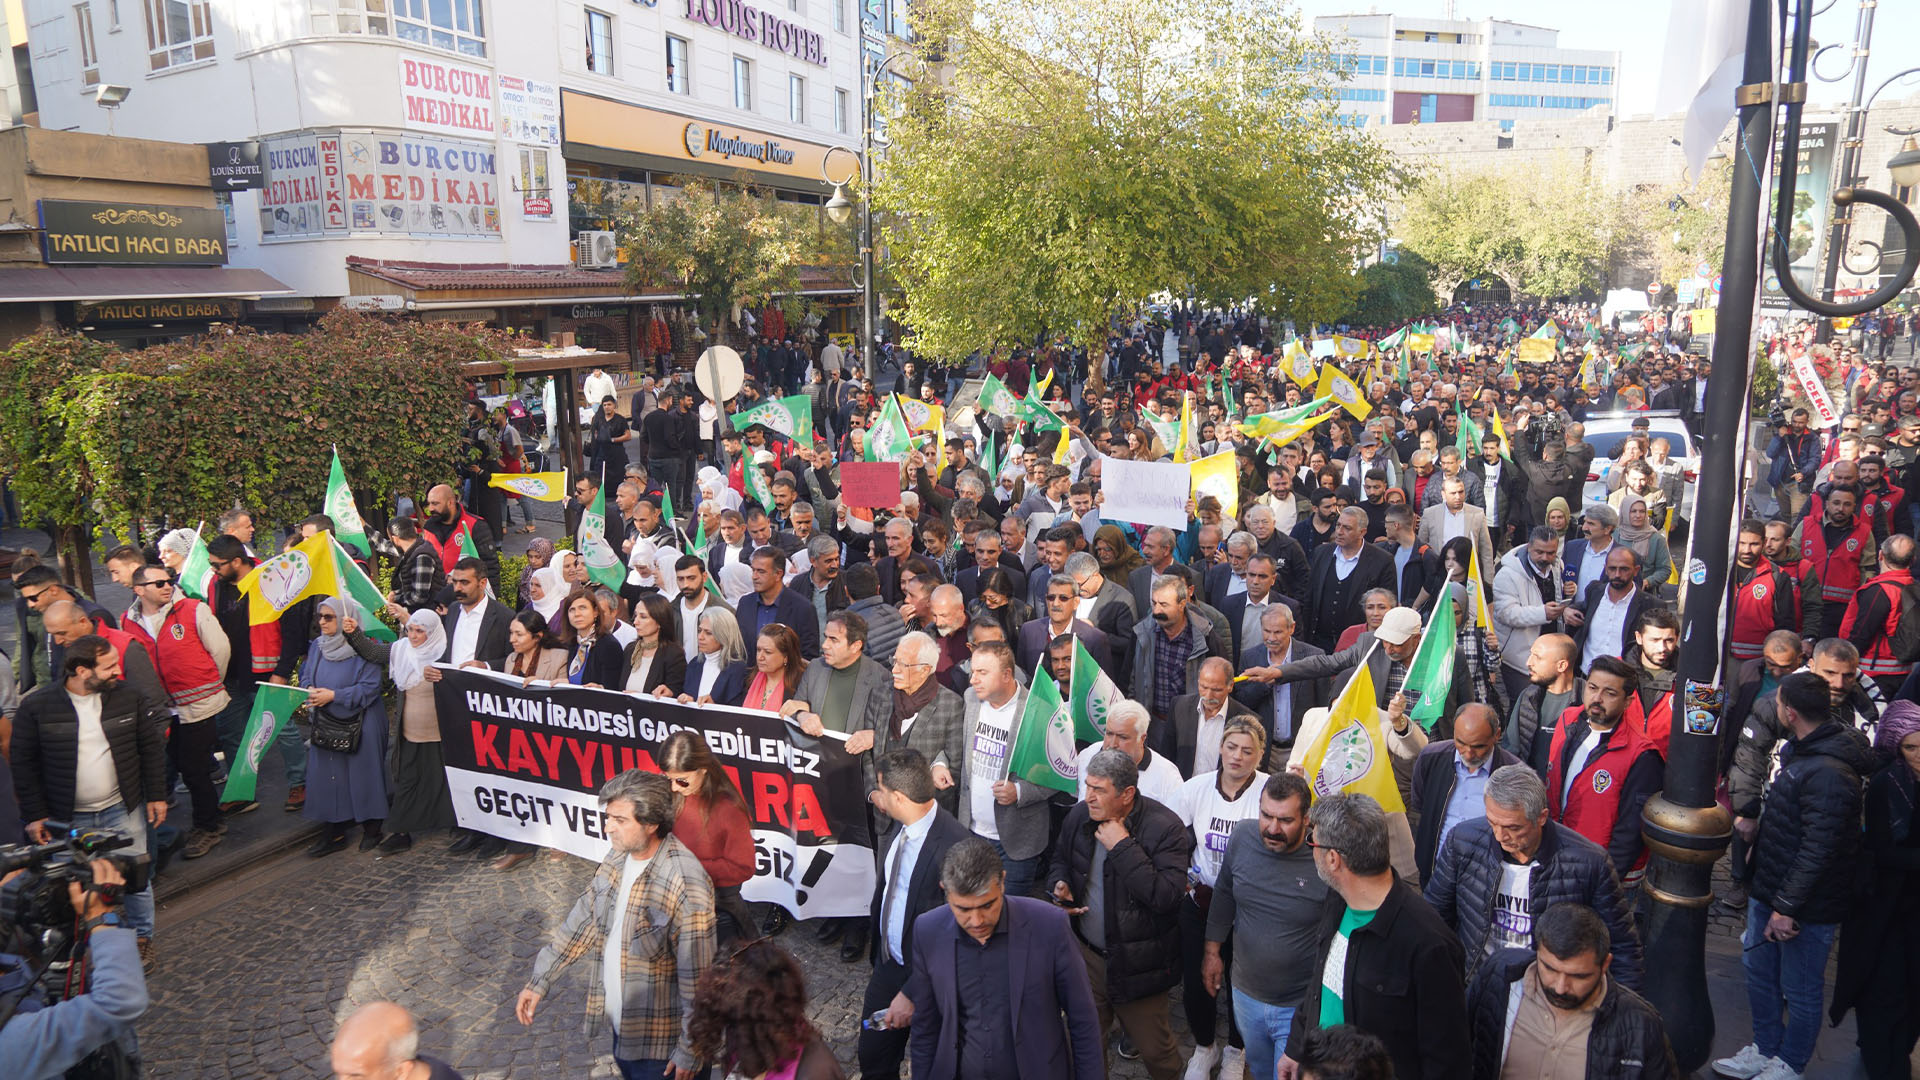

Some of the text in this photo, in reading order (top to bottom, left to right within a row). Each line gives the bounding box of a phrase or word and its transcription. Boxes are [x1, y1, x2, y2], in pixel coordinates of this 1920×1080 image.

[761, 11, 828, 68] HOTEL
[404, 59, 491, 100] BURCUM
[406, 95, 494, 132] MEDİKAL
[269, 146, 317, 170] BURCUM
[379, 141, 497, 175] BURCUM
[706, 129, 796, 164] Maydonoz Döner
[235, 165, 262, 175] HOTEL
[262, 175, 320, 206] MEDİKAL
[346, 171, 496, 206] MEDİKAL
[48, 233, 223, 255] TATLICI HACI BABA
[96, 303, 222, 319] TATLICI HACI BABA
[571, 304, 605, 319] Gültekin
[466, 690, 543, 726] HALKIN
[546, 697, 635, 739] İRADESİ
[704, 727, 821, 778] EDİLEMEZ
[976, 721, 1009, 742] KAYYUM
[1054, 757, 1070, 773] DEM
[1315, 768, 1327, 789] DEM
[474, 786, 554, 827] GEÇİT
